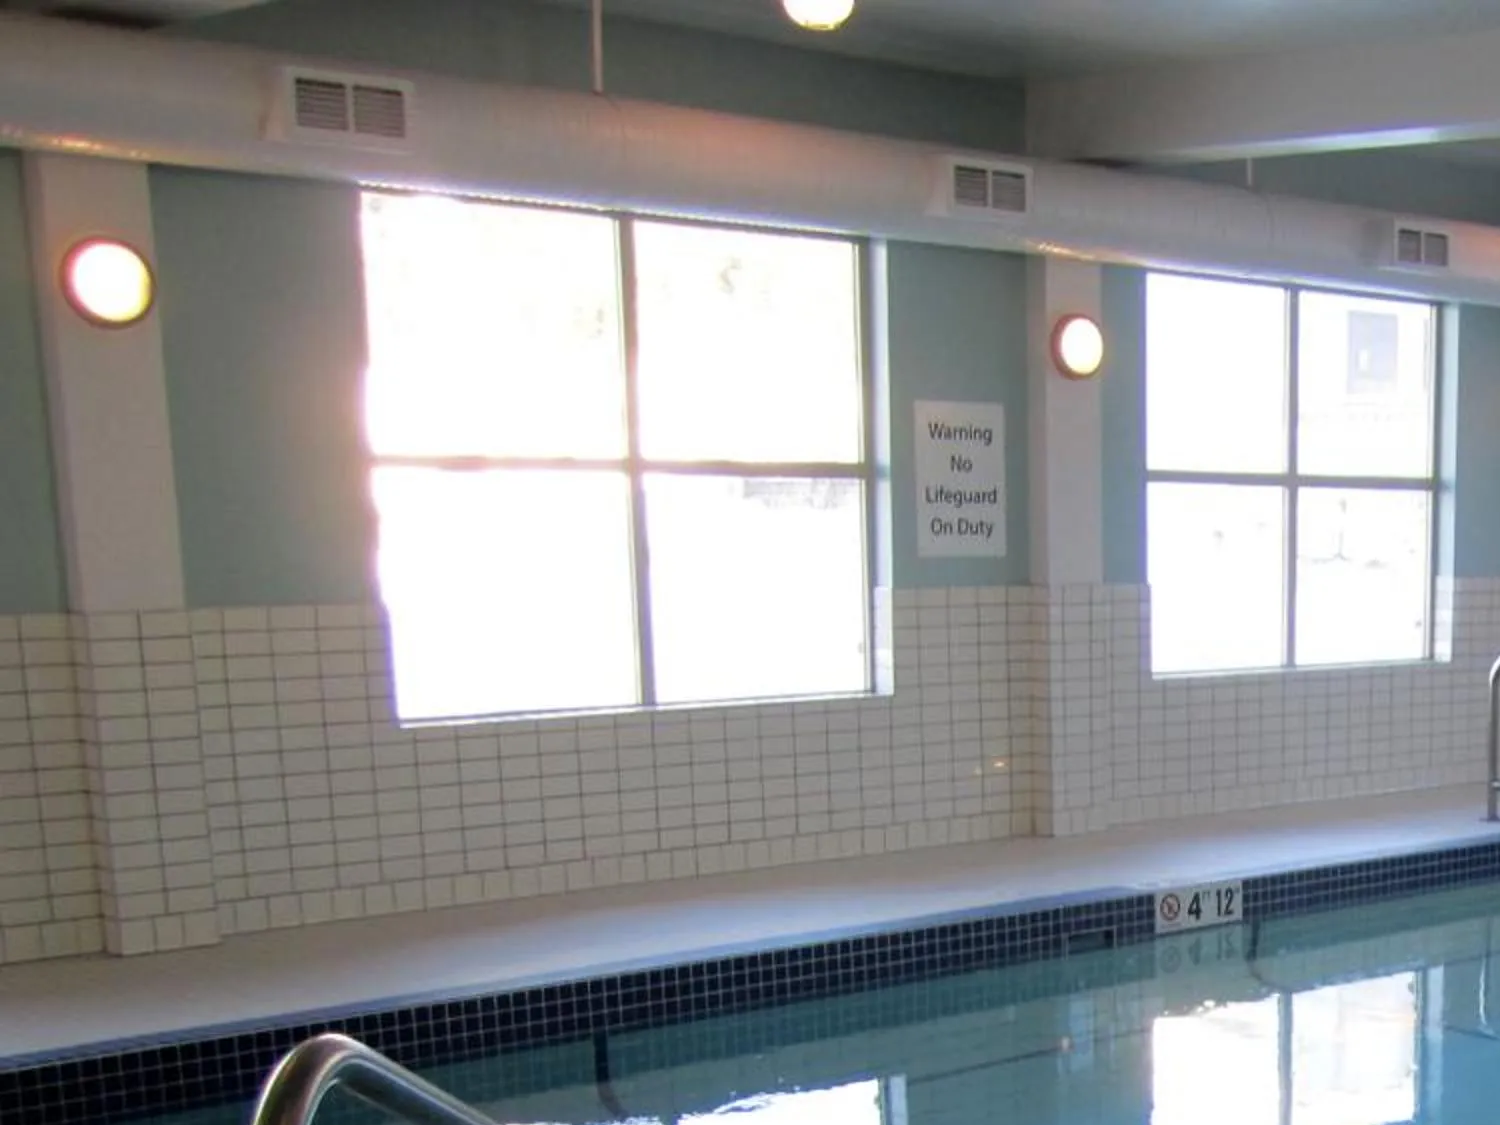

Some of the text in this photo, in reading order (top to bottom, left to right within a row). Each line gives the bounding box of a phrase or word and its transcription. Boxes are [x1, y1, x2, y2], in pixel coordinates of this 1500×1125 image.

[928, 422, 993, 446] Warning
[950, 455, 973, 473] No
[925, 485, 998, 508] Lifeguard
[931, 517, 994, 538] On Duty
[1187, 891, 1202, 920] 4
